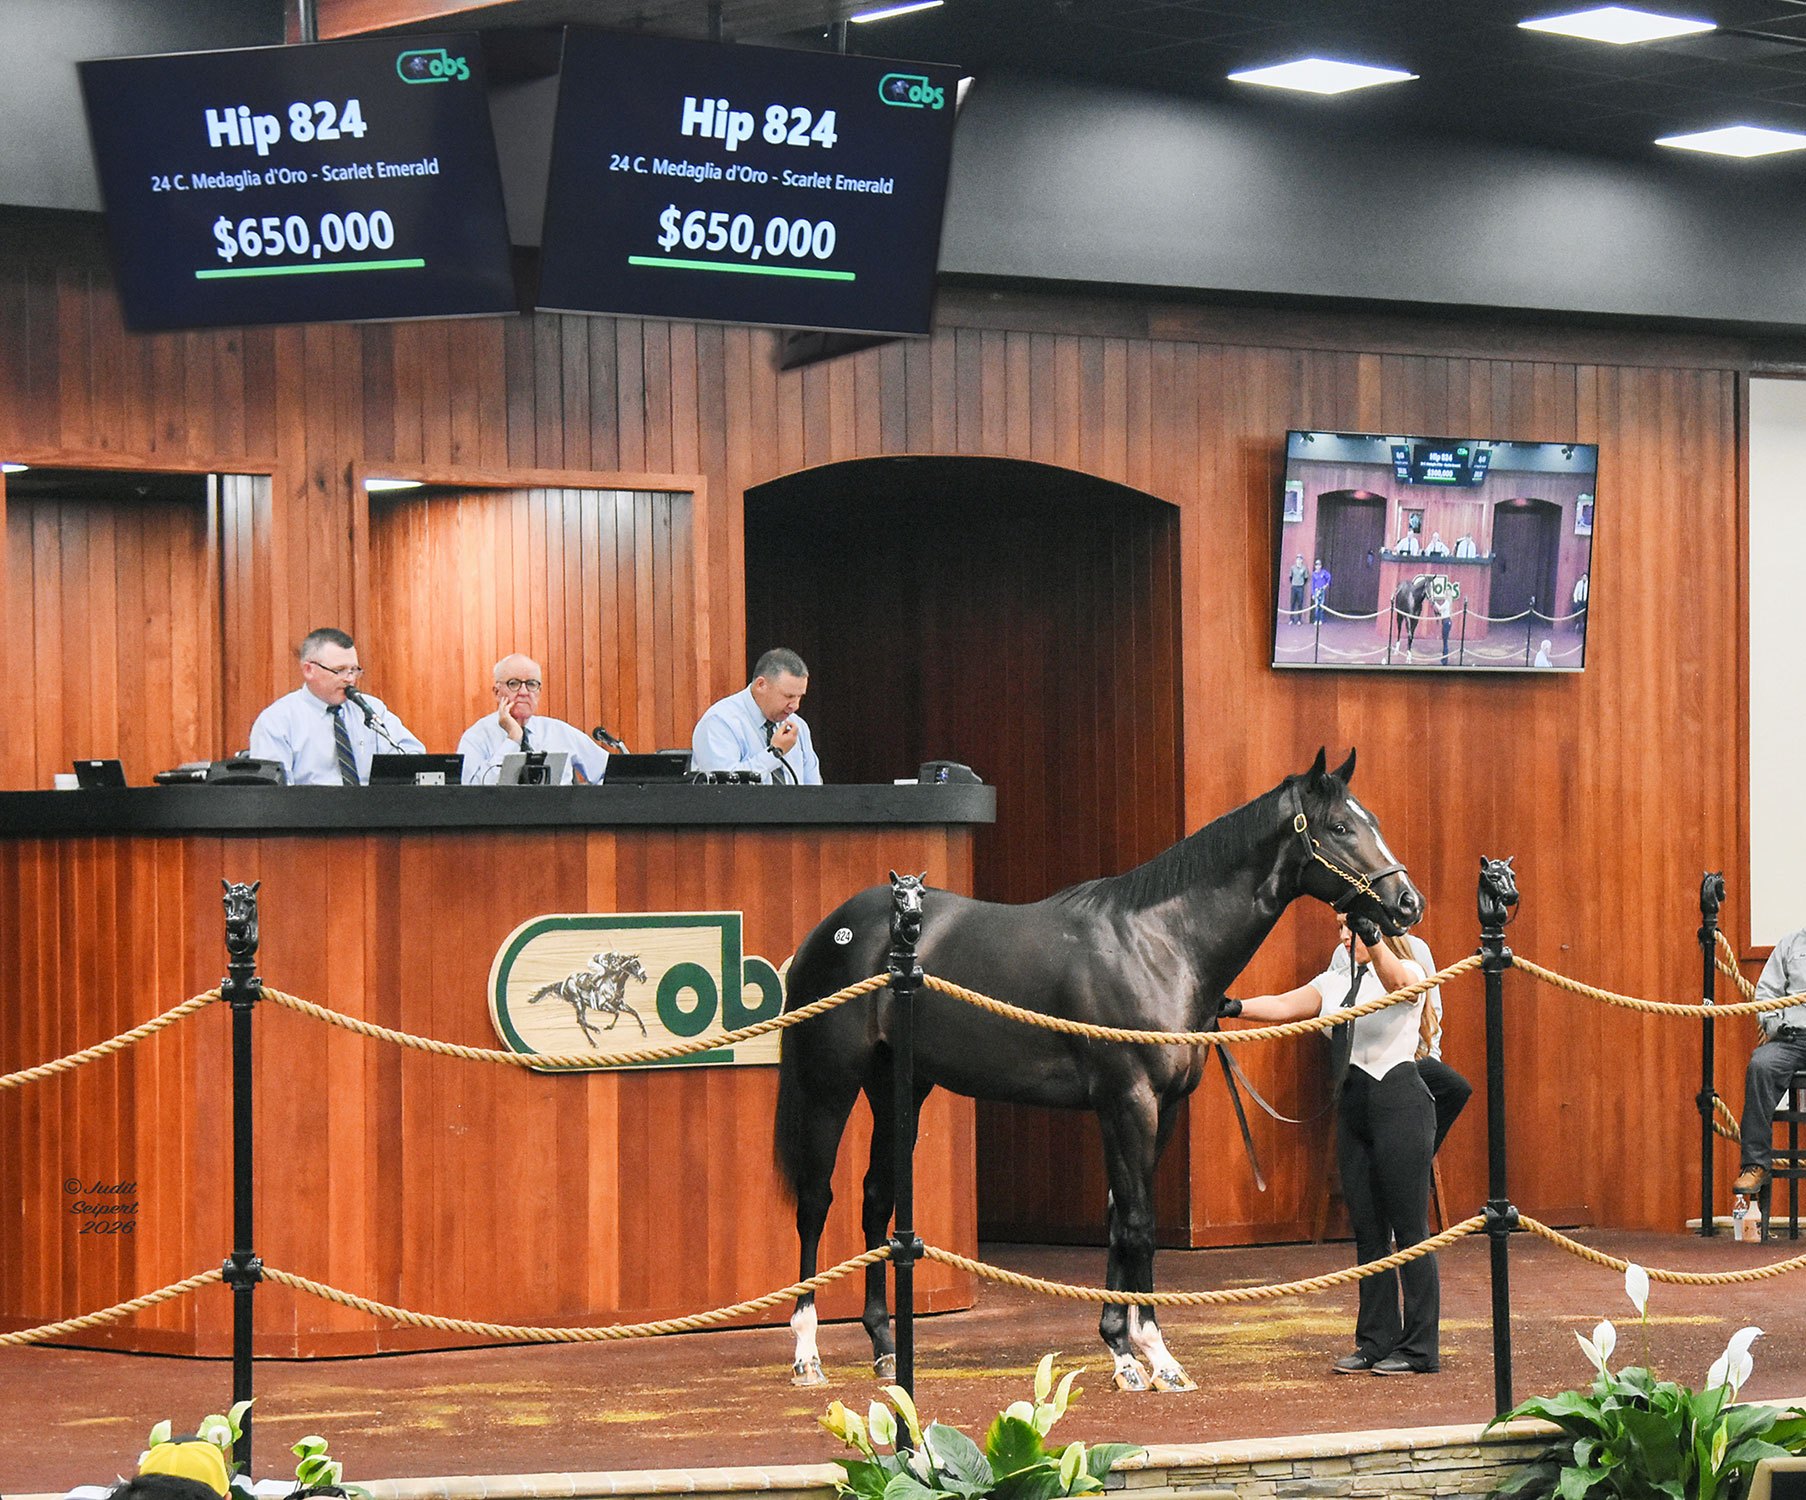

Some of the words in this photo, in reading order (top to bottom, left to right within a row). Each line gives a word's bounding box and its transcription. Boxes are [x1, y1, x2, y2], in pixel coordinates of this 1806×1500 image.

[428, 49, 471, 81] obs
[908, 76, 946, 110] obs
[205, 105, 281, 156] Hip
[288, 99, 367, 143] 824
[681, 96, 755, 151] Hip
[762, 104, 838, 149] 824
[151, 175, 171, 192] 24
[173, 174, 190, 191] C.
[191, 169, 262, 192] Medaglia
[264, 167, 308, 185] d'Oro
[321, 162, 374, 182] Scarlet
[376, 157, 440, 178] Emerald
[609, 154, 630, 172] 24
[633, 156, 648, 174] C.
[652, 158, 723, 183] Medaglia
[725, 164, 768, 184] d'Oro
[781, 169, 833, 190] Scarlet
[835, 174, 894, 195] Emerald
[213, 210, 395, 262] $650,000
[657, 203, 836, 260] $650,000
[836, 930, 850, 941] 824
[656, 914, 783, 1037] ob
